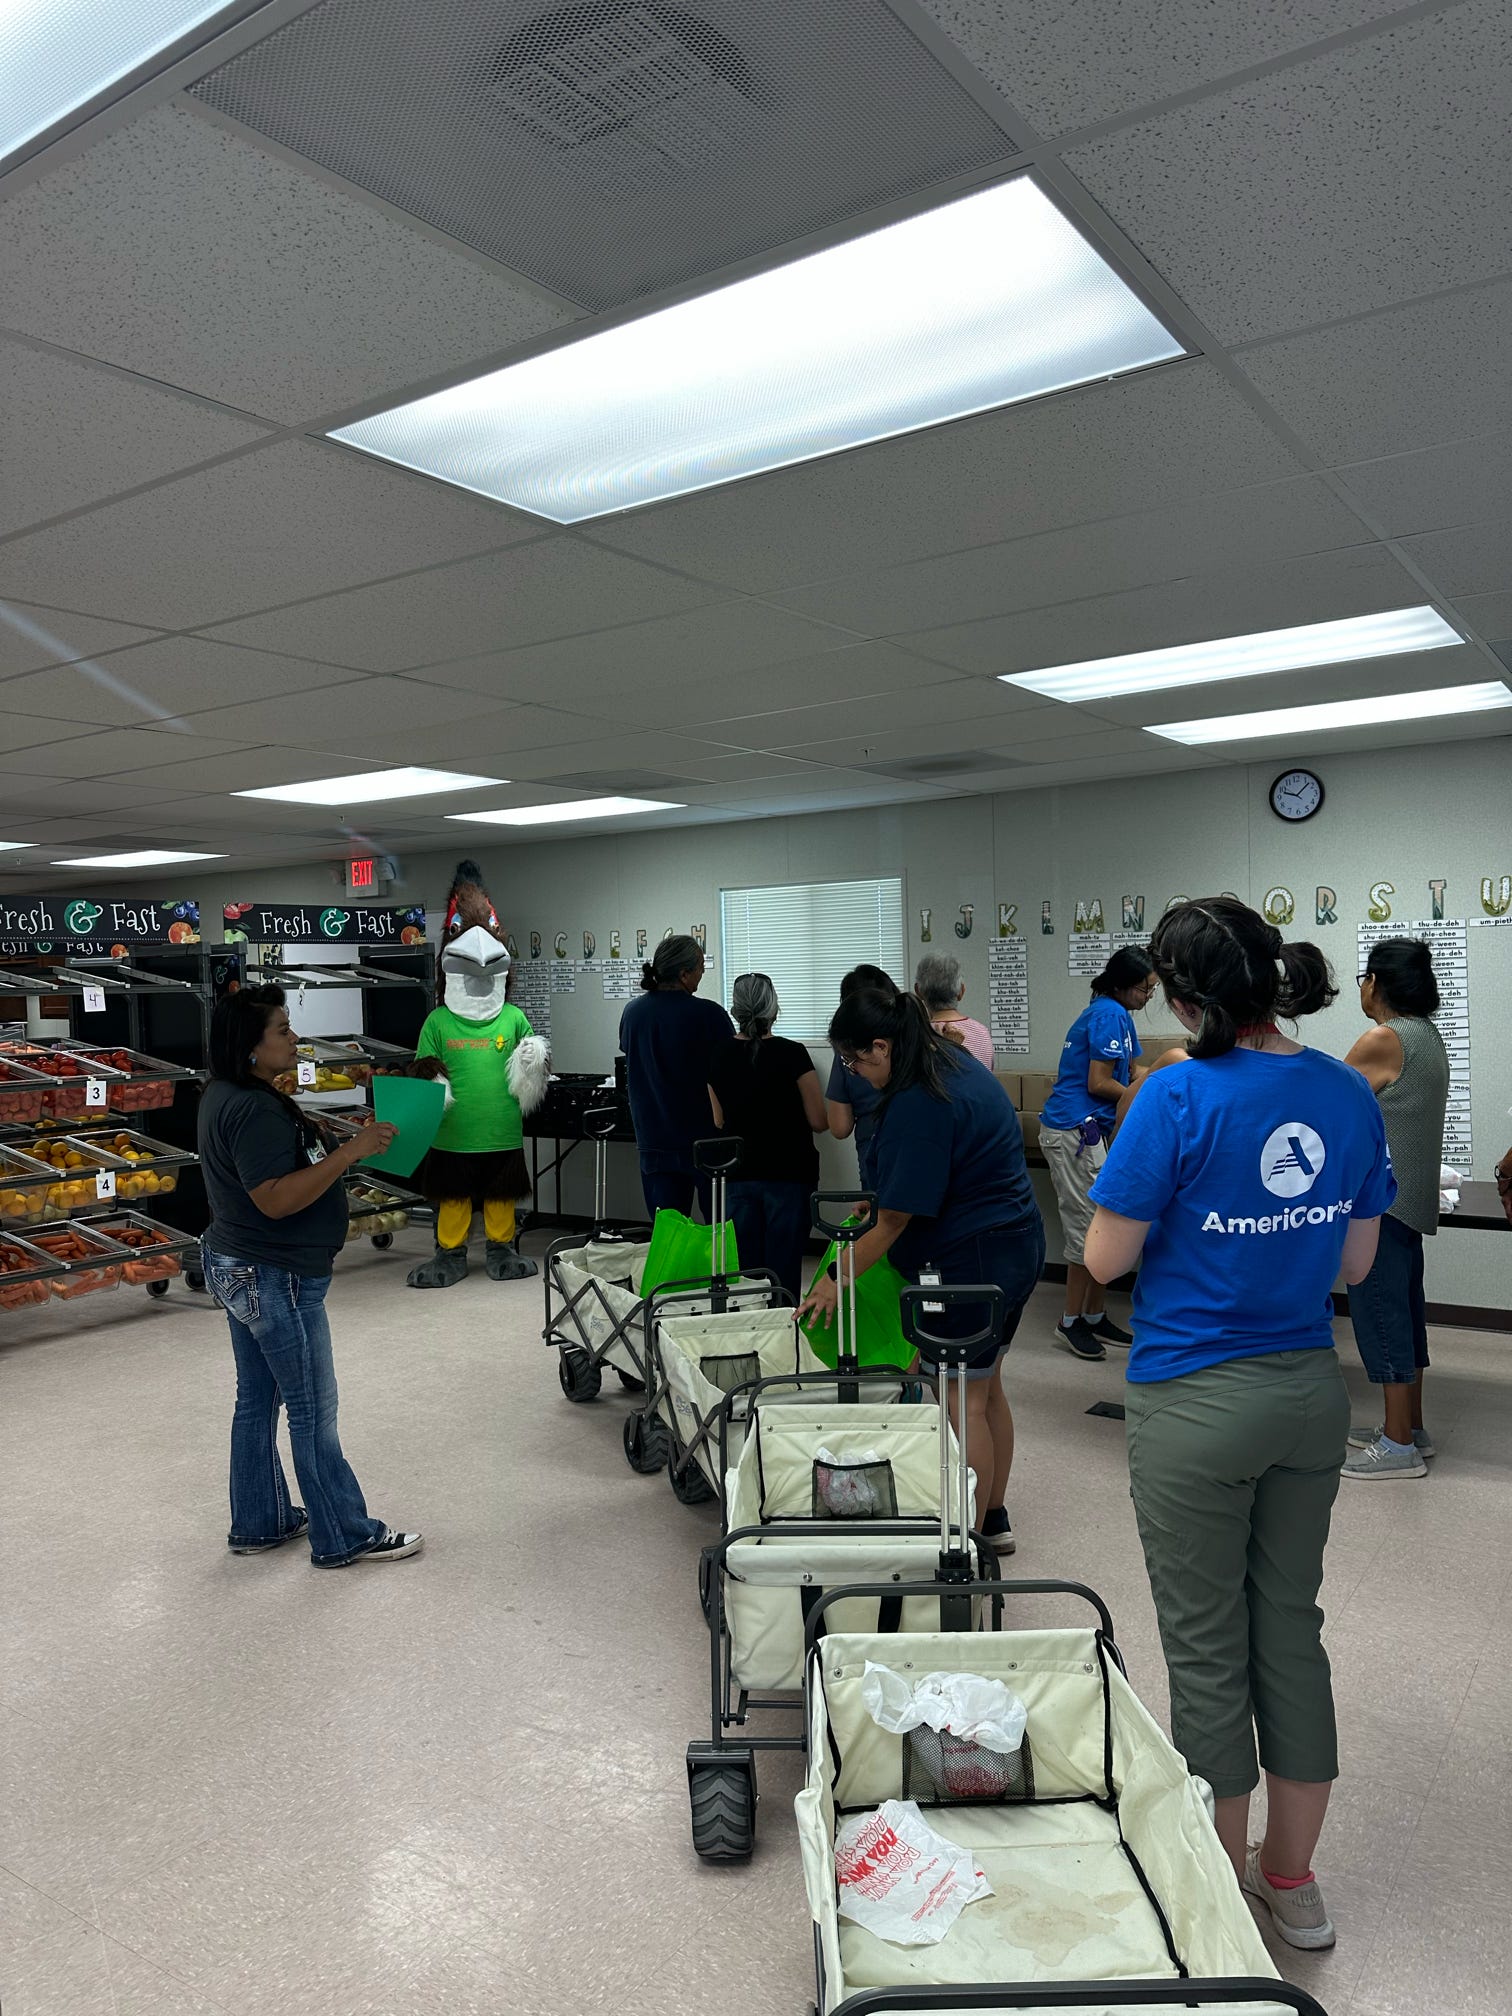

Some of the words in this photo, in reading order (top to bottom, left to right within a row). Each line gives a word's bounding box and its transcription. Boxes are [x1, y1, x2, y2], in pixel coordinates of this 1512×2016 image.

[1287, 807, 1292, 815] 7
[1304, 805, 1310, 813] 5
[352, 861, 373, 886] EXIT
[0, 901, 54, 935] resh
[70, 901, 103, 934] &
[110, 903, 161, 935] Fast
[920, 908, 932, 942] I
[954, 904, 975, 939] J
[998, 904, 1018, 937] K
[1042, 901, 1054, 935] L
[1073, 898, 1105, 934] M
[1122, 895, 1144, 932] N
[1264, 886, 1295, 925] Q
[1316, 885, 1338, 925] R
[1368, 881, 1394, 923] S
[1428, 878, 1446, 920] T
[1481, 876, 1511, 917] U
[260, 909, 312, 937] Fresh
[324, 909, 350, 937] &
[356, 910, 395, 937] Fast
[507, 935, 519, 959] A
[530, 931, 541, 959] B
[554, 931, 568, 959] C
[583, 931, 595, 959] D
[610, 930, 620, 958] E
[637, 930, 648, 957] F
[691, 925, 706, 955] H
[89, 994, 98, 1007] 4
[301, 1069, 312, 1083] 5
[92, 1087, 100, 1100] 3
[102, 1179, 110, 1191] 4
[866, 1827, 898, 1863] YOU
